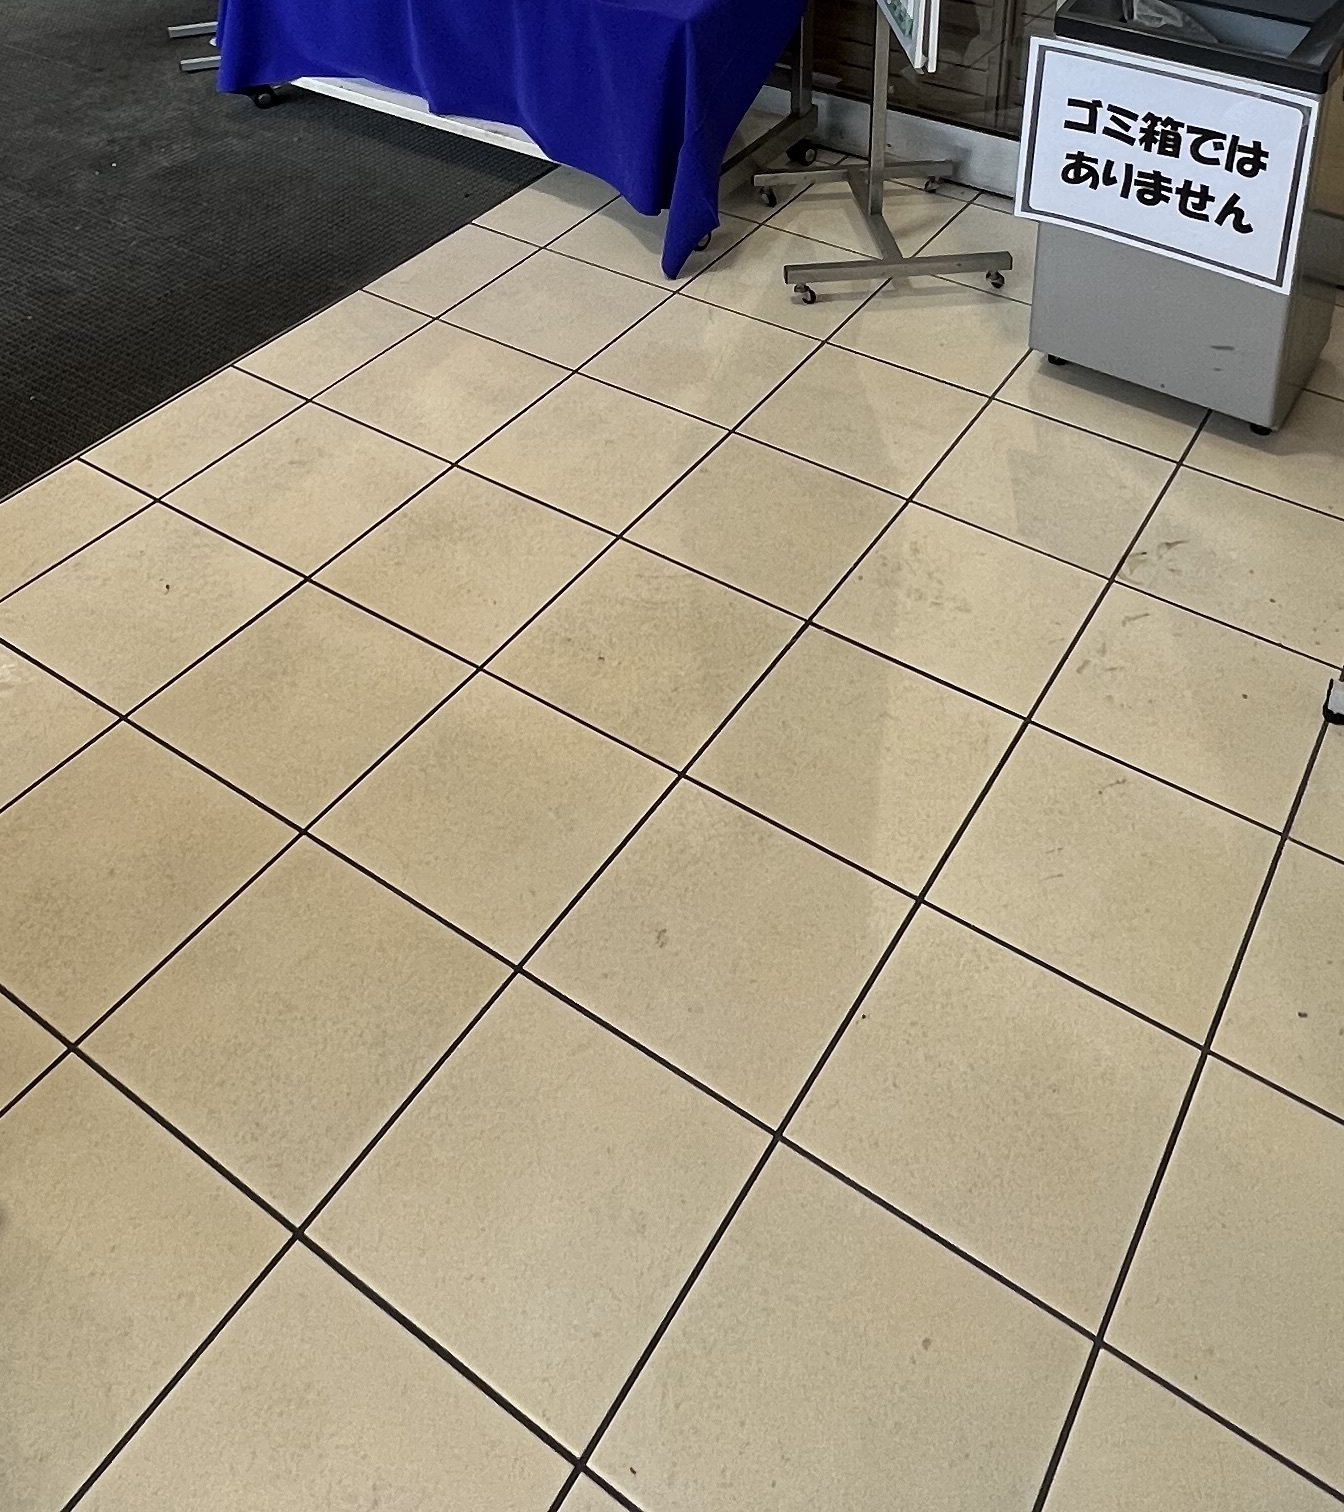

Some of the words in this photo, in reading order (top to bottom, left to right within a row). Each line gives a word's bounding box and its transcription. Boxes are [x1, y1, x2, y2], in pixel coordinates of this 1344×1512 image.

[1062, 97, 1270, 180] ゴミ箱では
[1060, 149, 1255, 236] ありません
